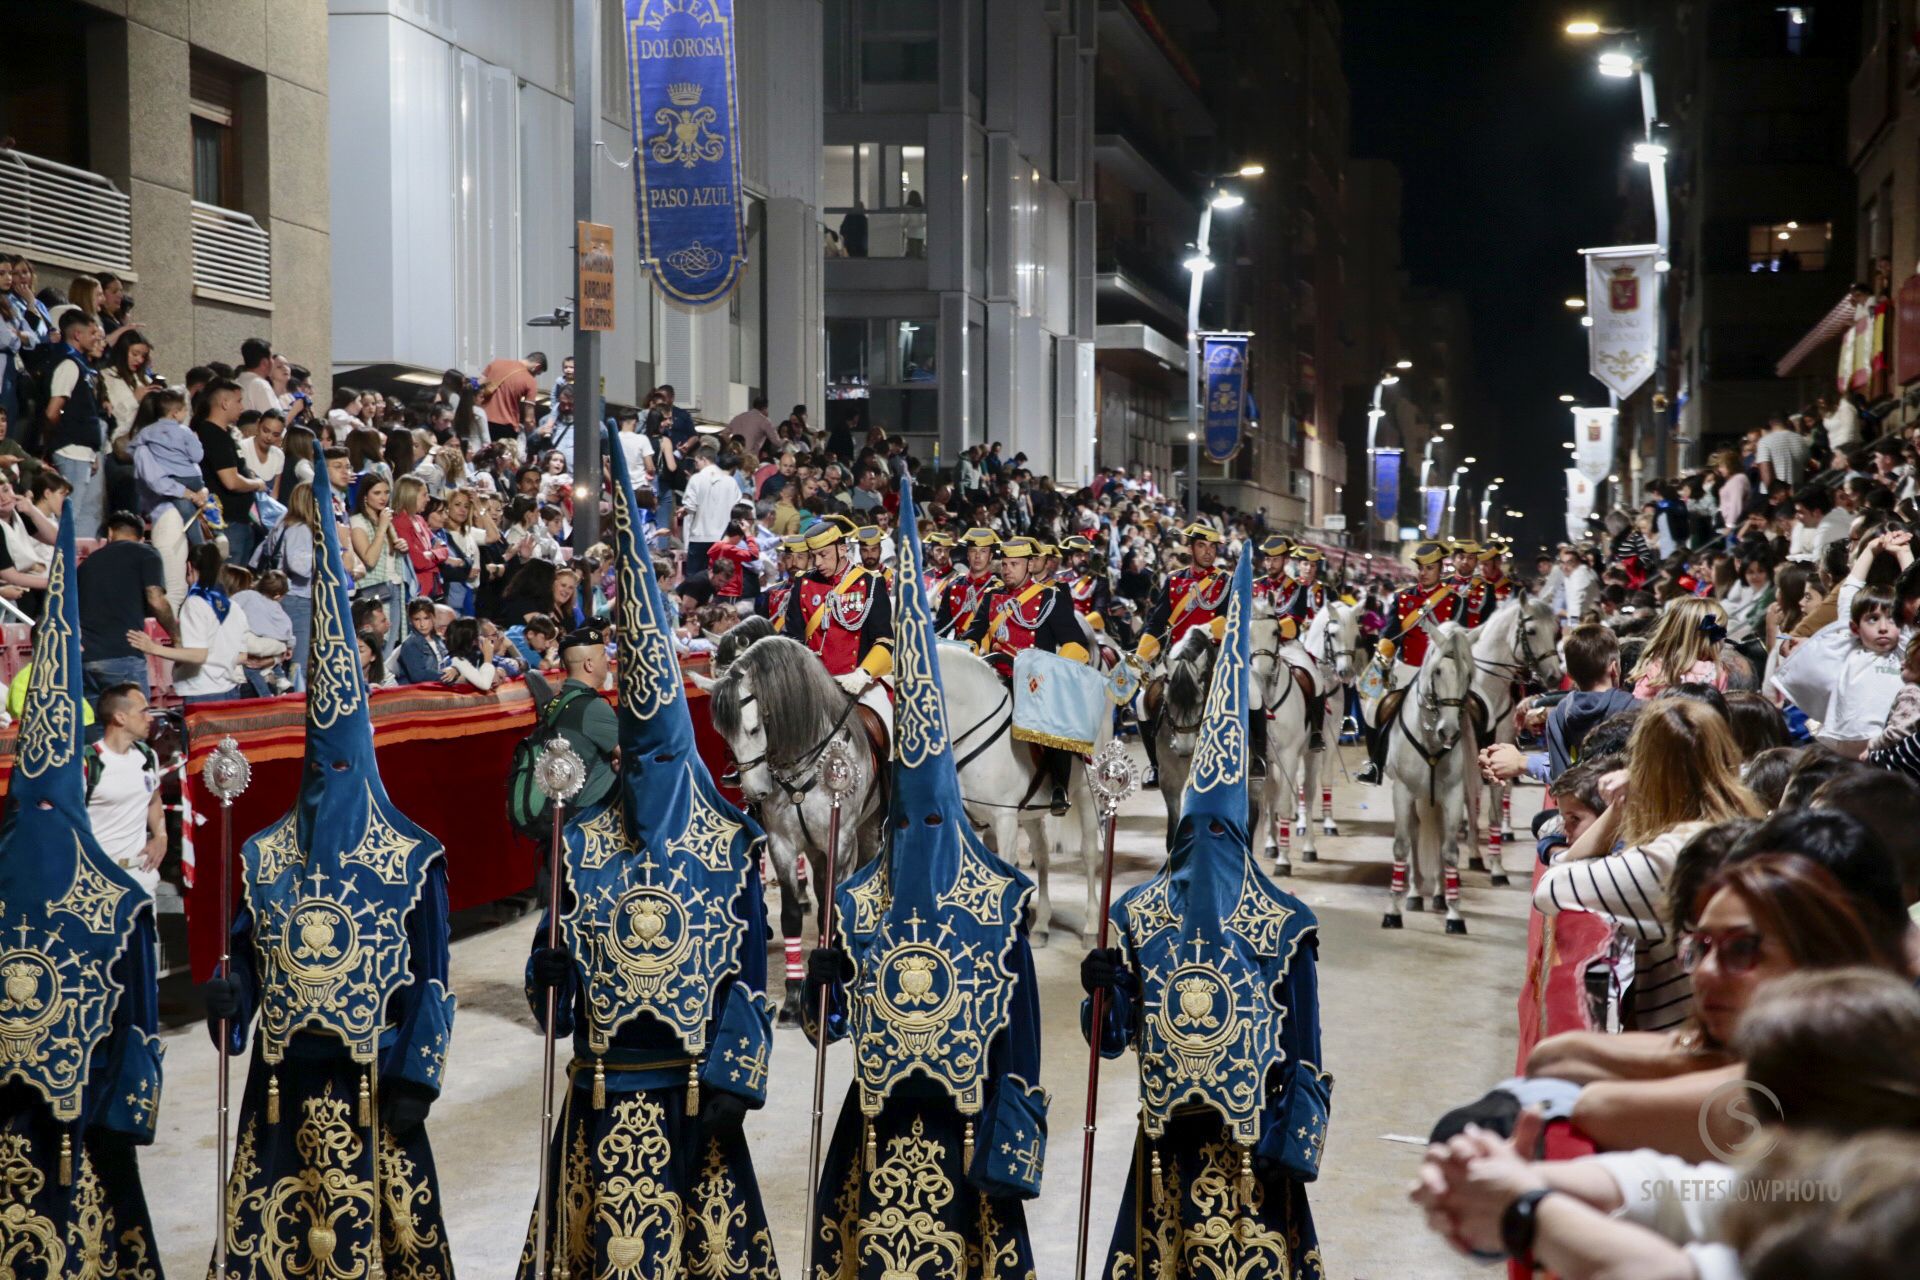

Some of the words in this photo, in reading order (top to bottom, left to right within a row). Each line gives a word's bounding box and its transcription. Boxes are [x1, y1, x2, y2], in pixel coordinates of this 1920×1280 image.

[645, 0, 713, 32] MATER
[641, 37, 723, 59] DOLOROSA
[650, 188, 688, 208] PASO
[691, 186, 731, 206] AZUL
